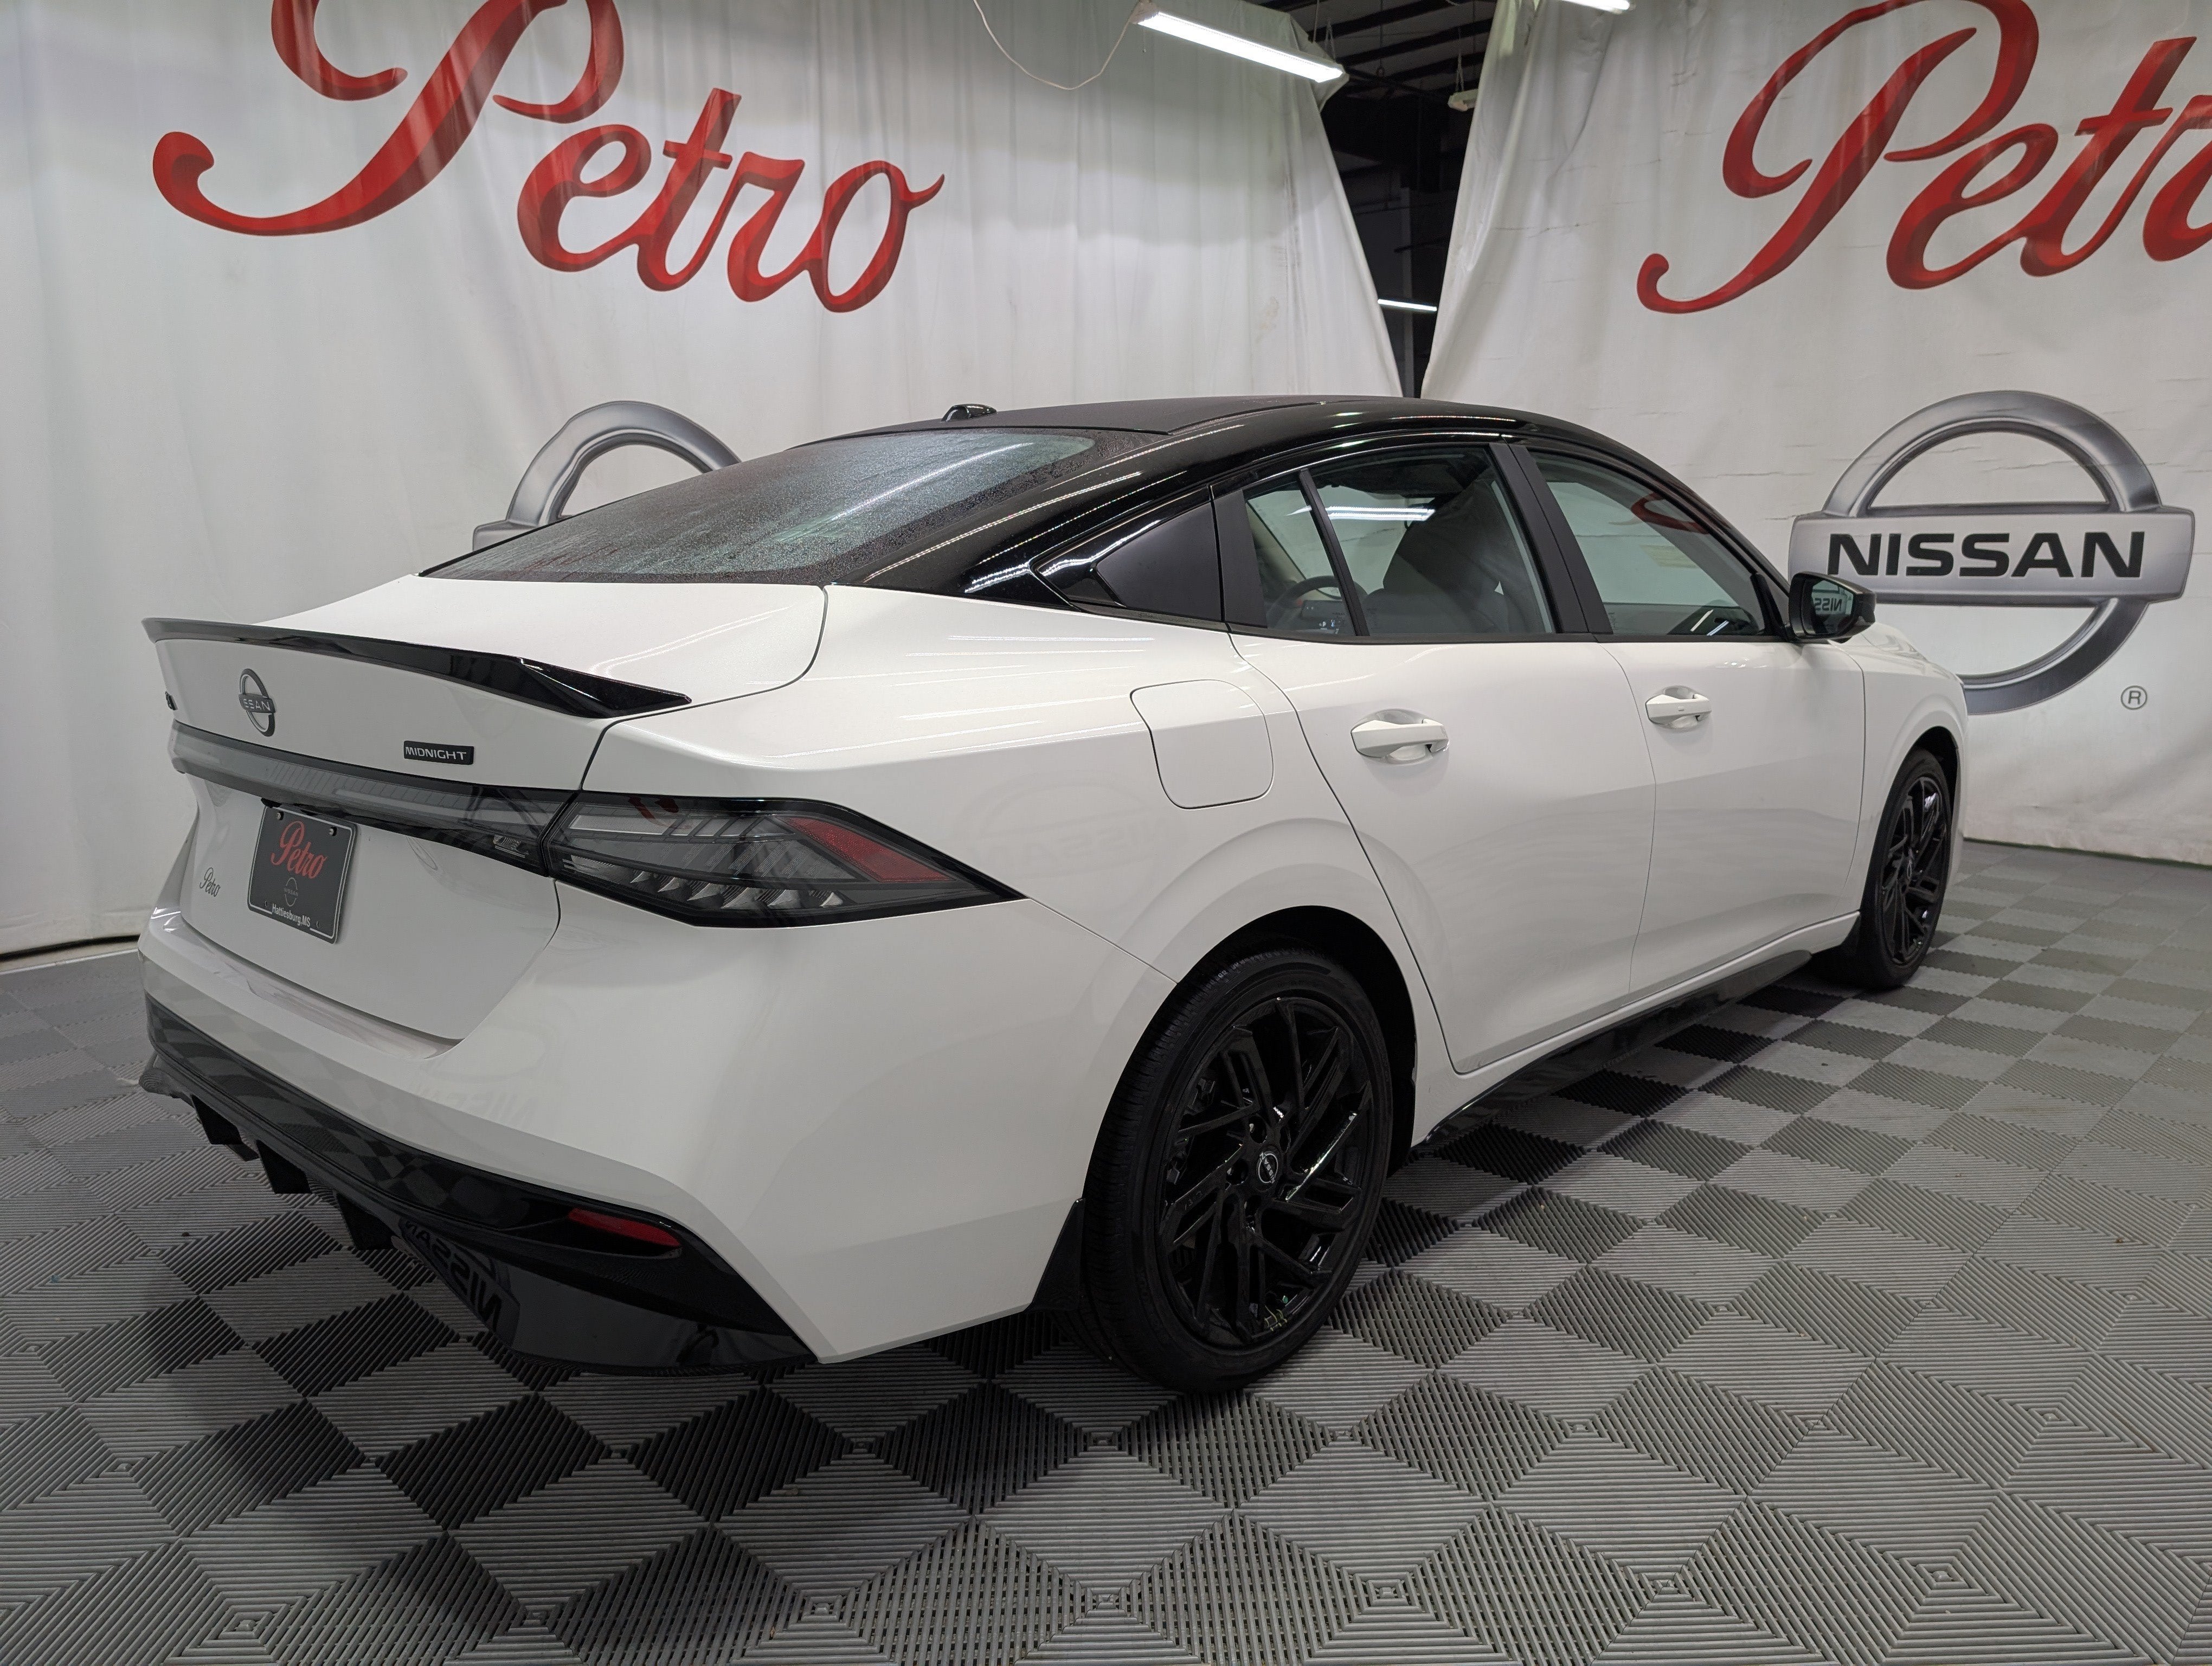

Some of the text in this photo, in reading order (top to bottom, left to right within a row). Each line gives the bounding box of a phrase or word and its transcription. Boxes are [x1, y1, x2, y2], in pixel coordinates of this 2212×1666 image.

[153, 0, 945, 313] Petro
[1827, 531, 2145, 578] NISSAN
[405, 746, 467, 760] MIDNIGHT
[271, 820, 327, 879] Petro
[200, 867, 221, 898] Petro
[1259, 1152, 1276, 1184] NISSAN
